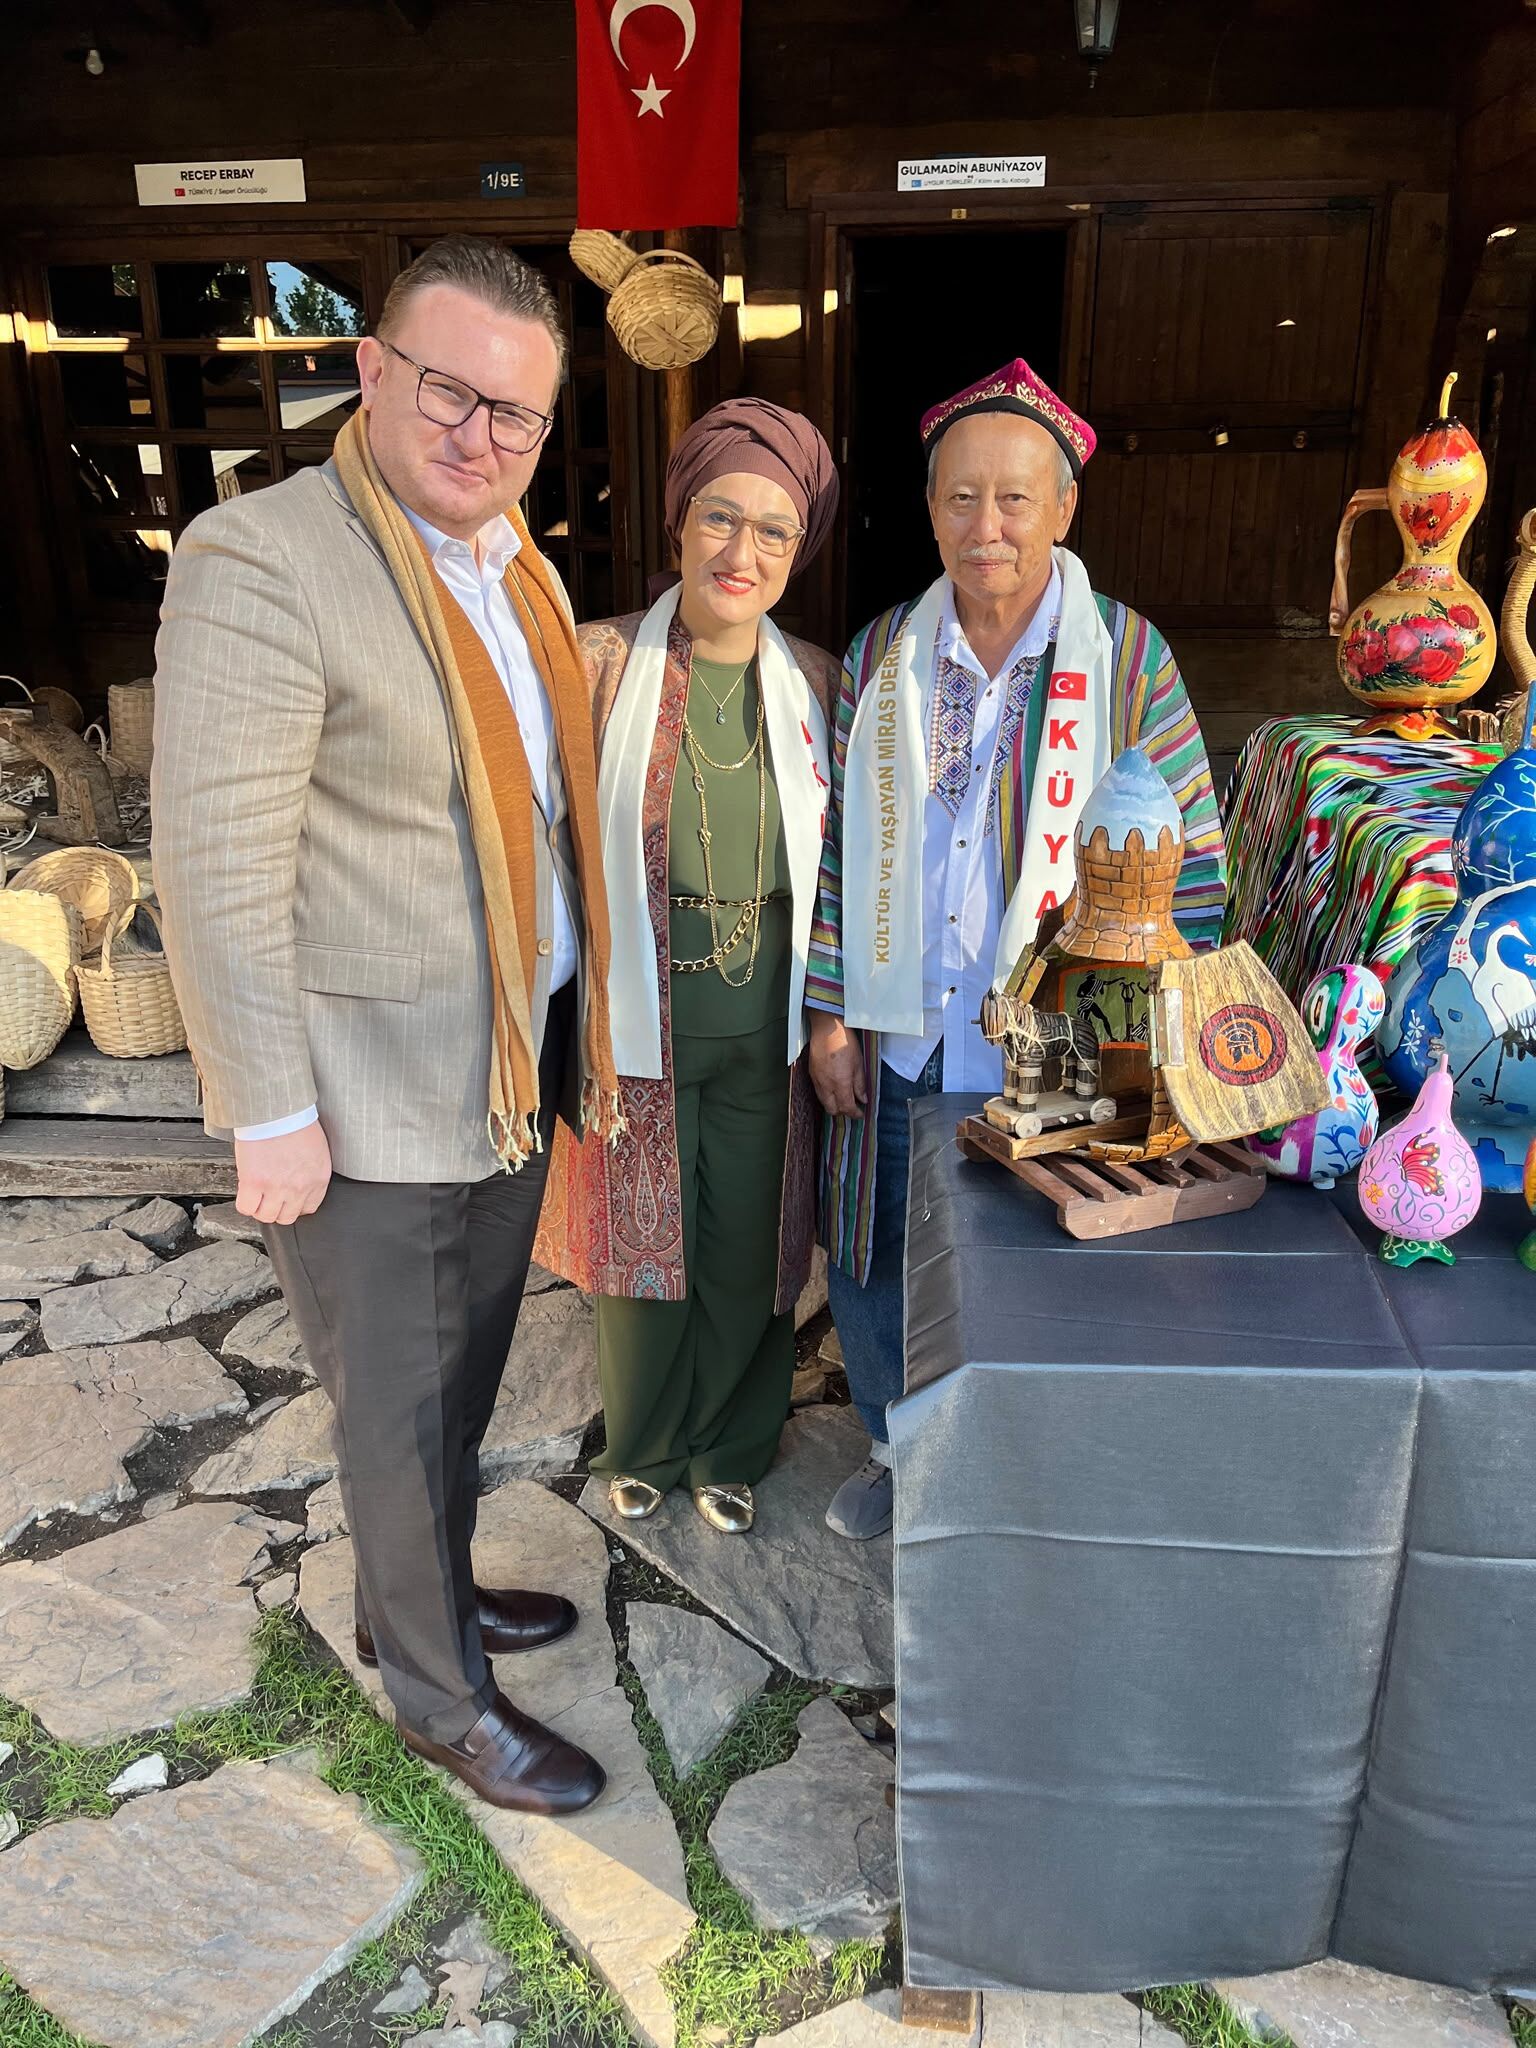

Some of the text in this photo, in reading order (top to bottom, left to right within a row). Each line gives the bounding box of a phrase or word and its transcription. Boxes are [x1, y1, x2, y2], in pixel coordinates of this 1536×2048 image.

[180, 168, 255, 181] RECEP ERBAY
[900, 160, 1043, 175] GULAMADİN ABUNİYAZOV
[486, 171, 520, 190] 1/9E
[874, 698, 897, 760] MİRAS
[878, 767, 900, 852] YAŞAYAN
[879, 858, 893, 882] VE
[873, 887, 891, 963] KÜLTÜR
